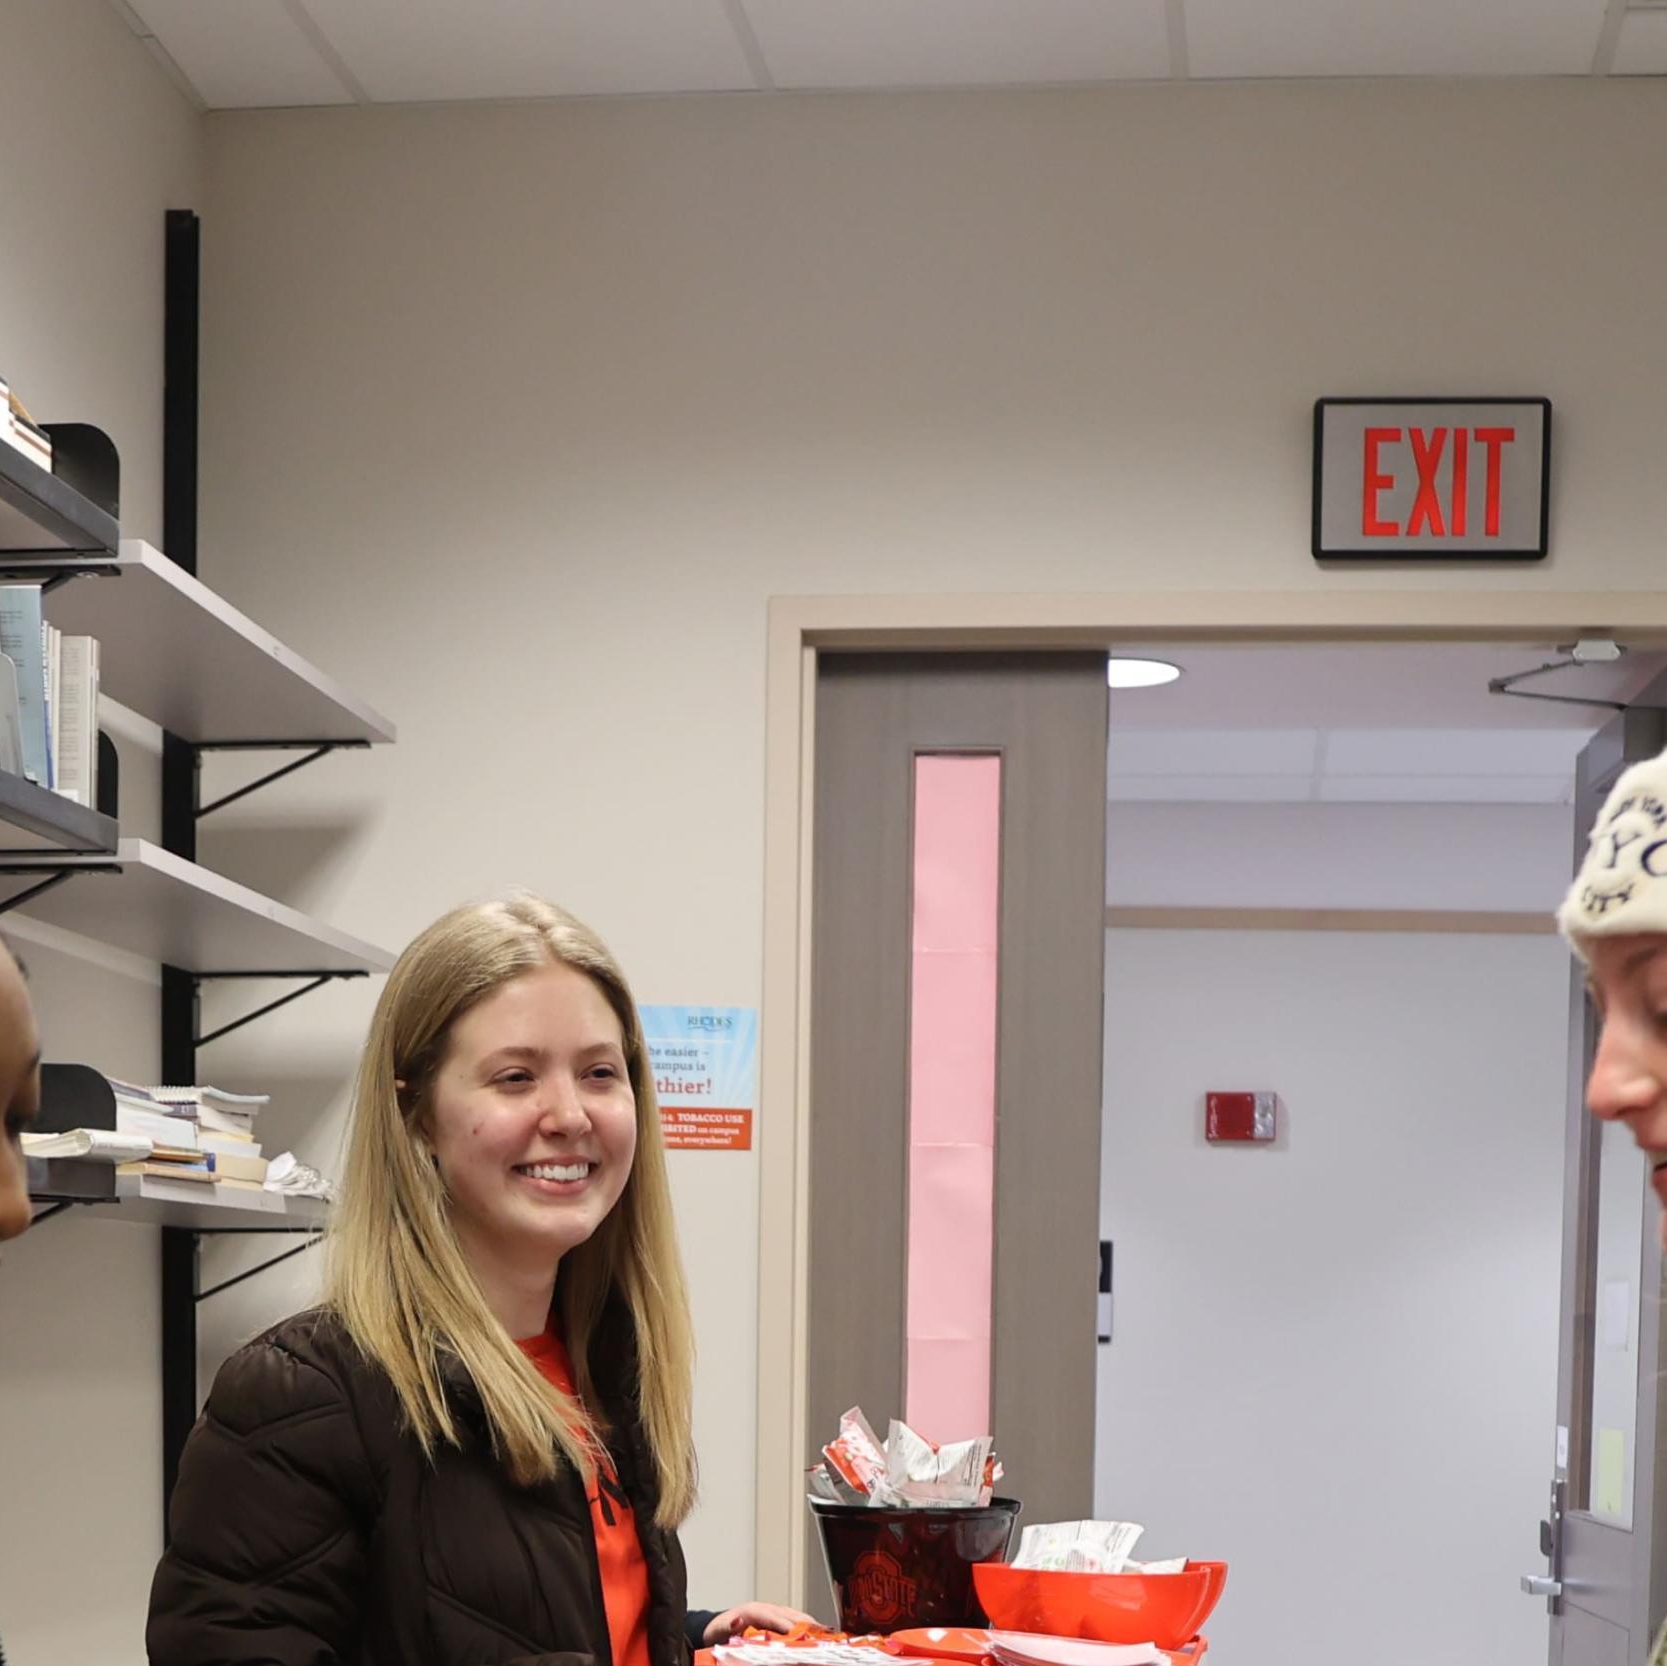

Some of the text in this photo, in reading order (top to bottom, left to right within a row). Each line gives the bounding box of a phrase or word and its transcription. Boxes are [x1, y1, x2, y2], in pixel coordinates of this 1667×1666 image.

[1362, 427, 1515, 537] EXIT
[665, 1046, 699, 1057] easier
[696, 1061, 706, 1071] is
[657, 1077, 712, 1095] thier!
[677, 1113, 723, 1123] TOBACCO
[725, 1115, 744, 1123] USE
